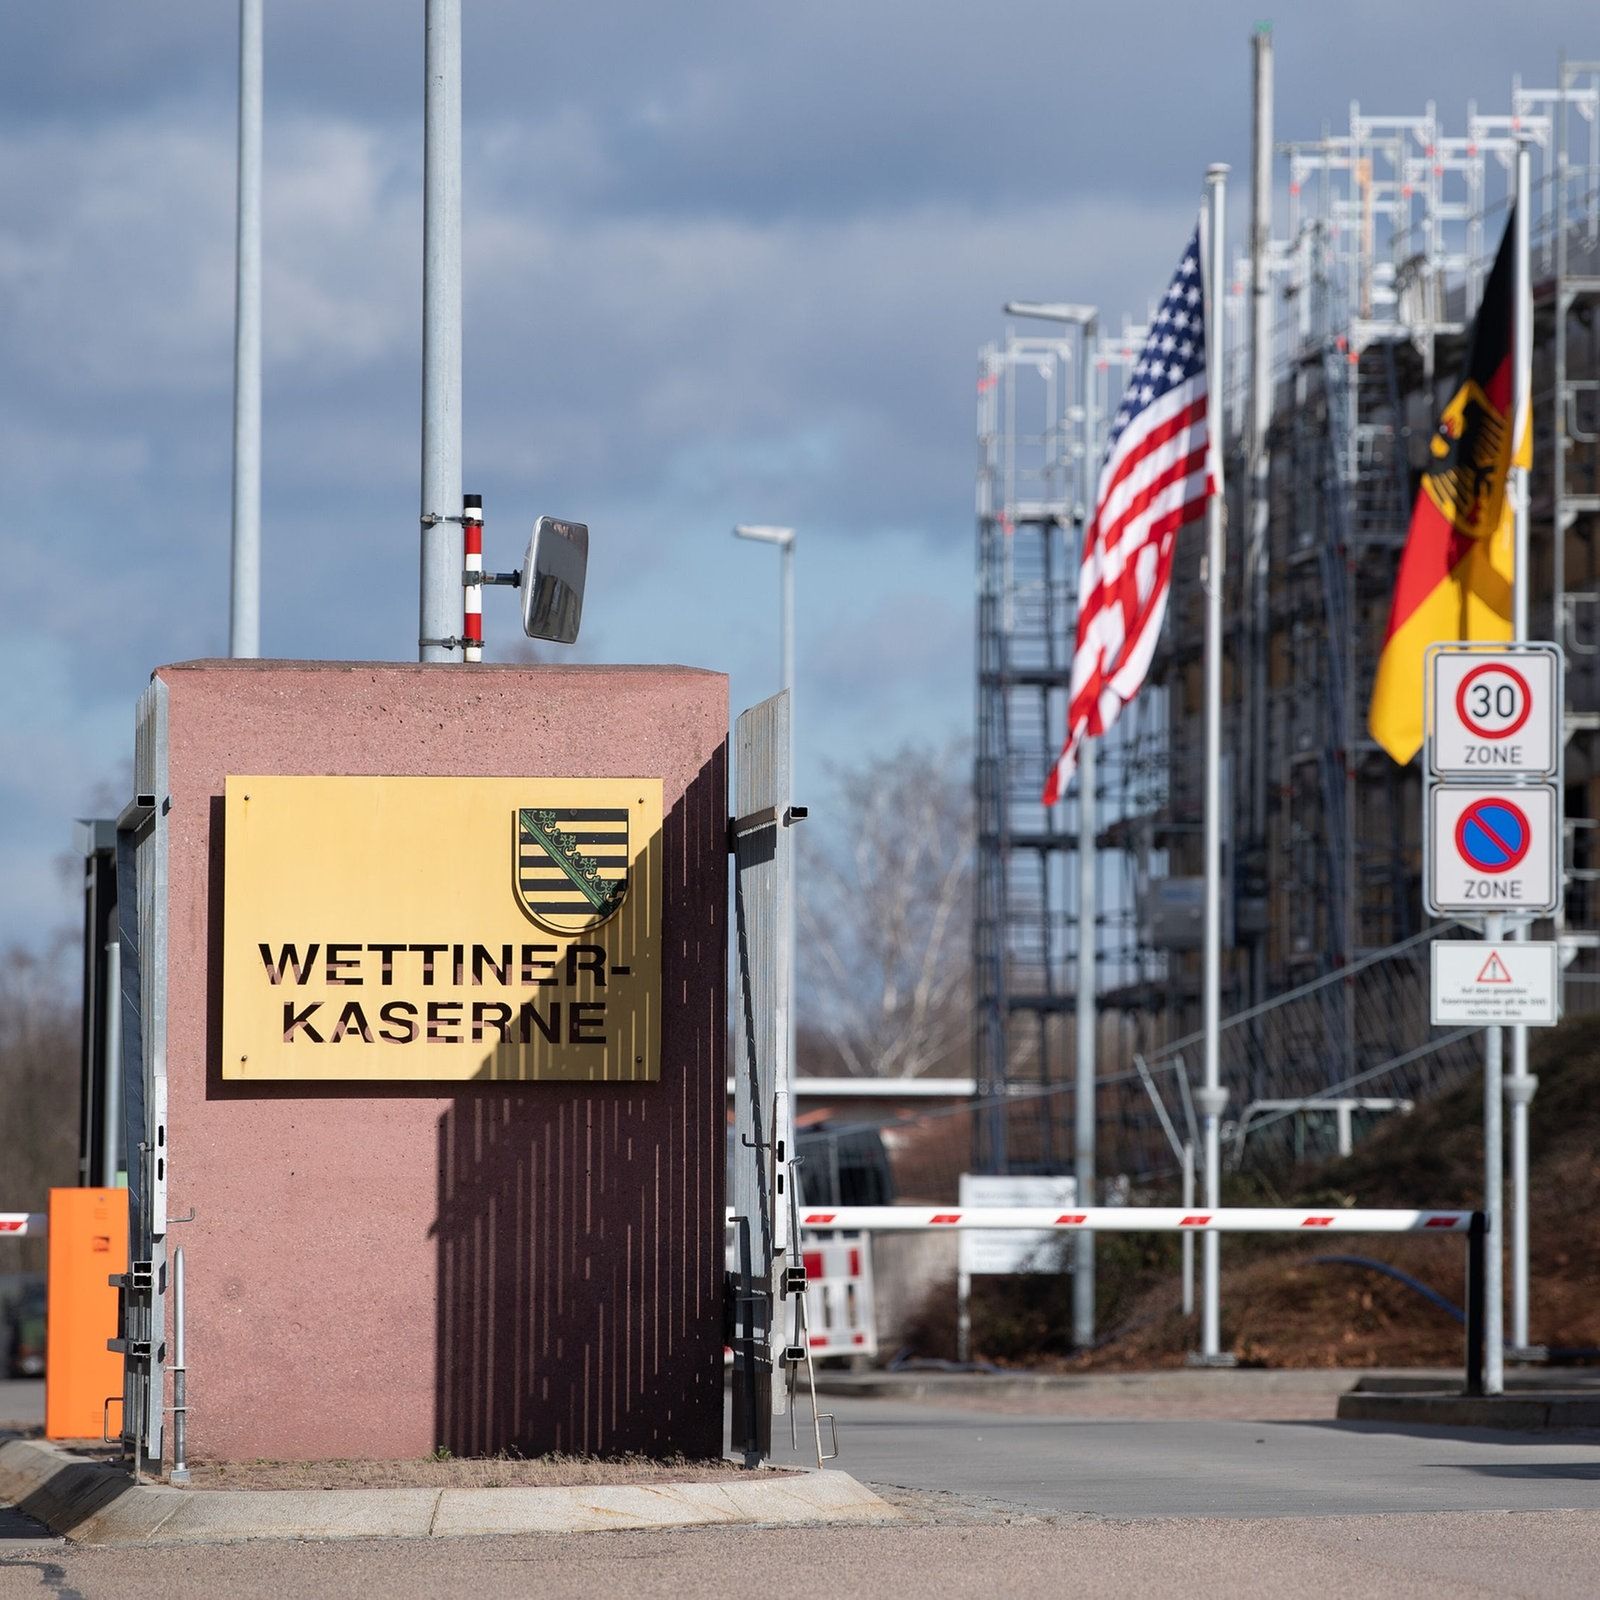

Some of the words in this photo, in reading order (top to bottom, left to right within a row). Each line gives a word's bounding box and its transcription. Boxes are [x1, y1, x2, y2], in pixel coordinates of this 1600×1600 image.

[1472, 685, 1515, 718] 30
[1464, 746, 1523, 765] ZONE
[1464, 880, 1523, 899] ZONE
[258, 943, 631, 987] WETTINER-
[282, 1001, 607, 1044] KASERNE
